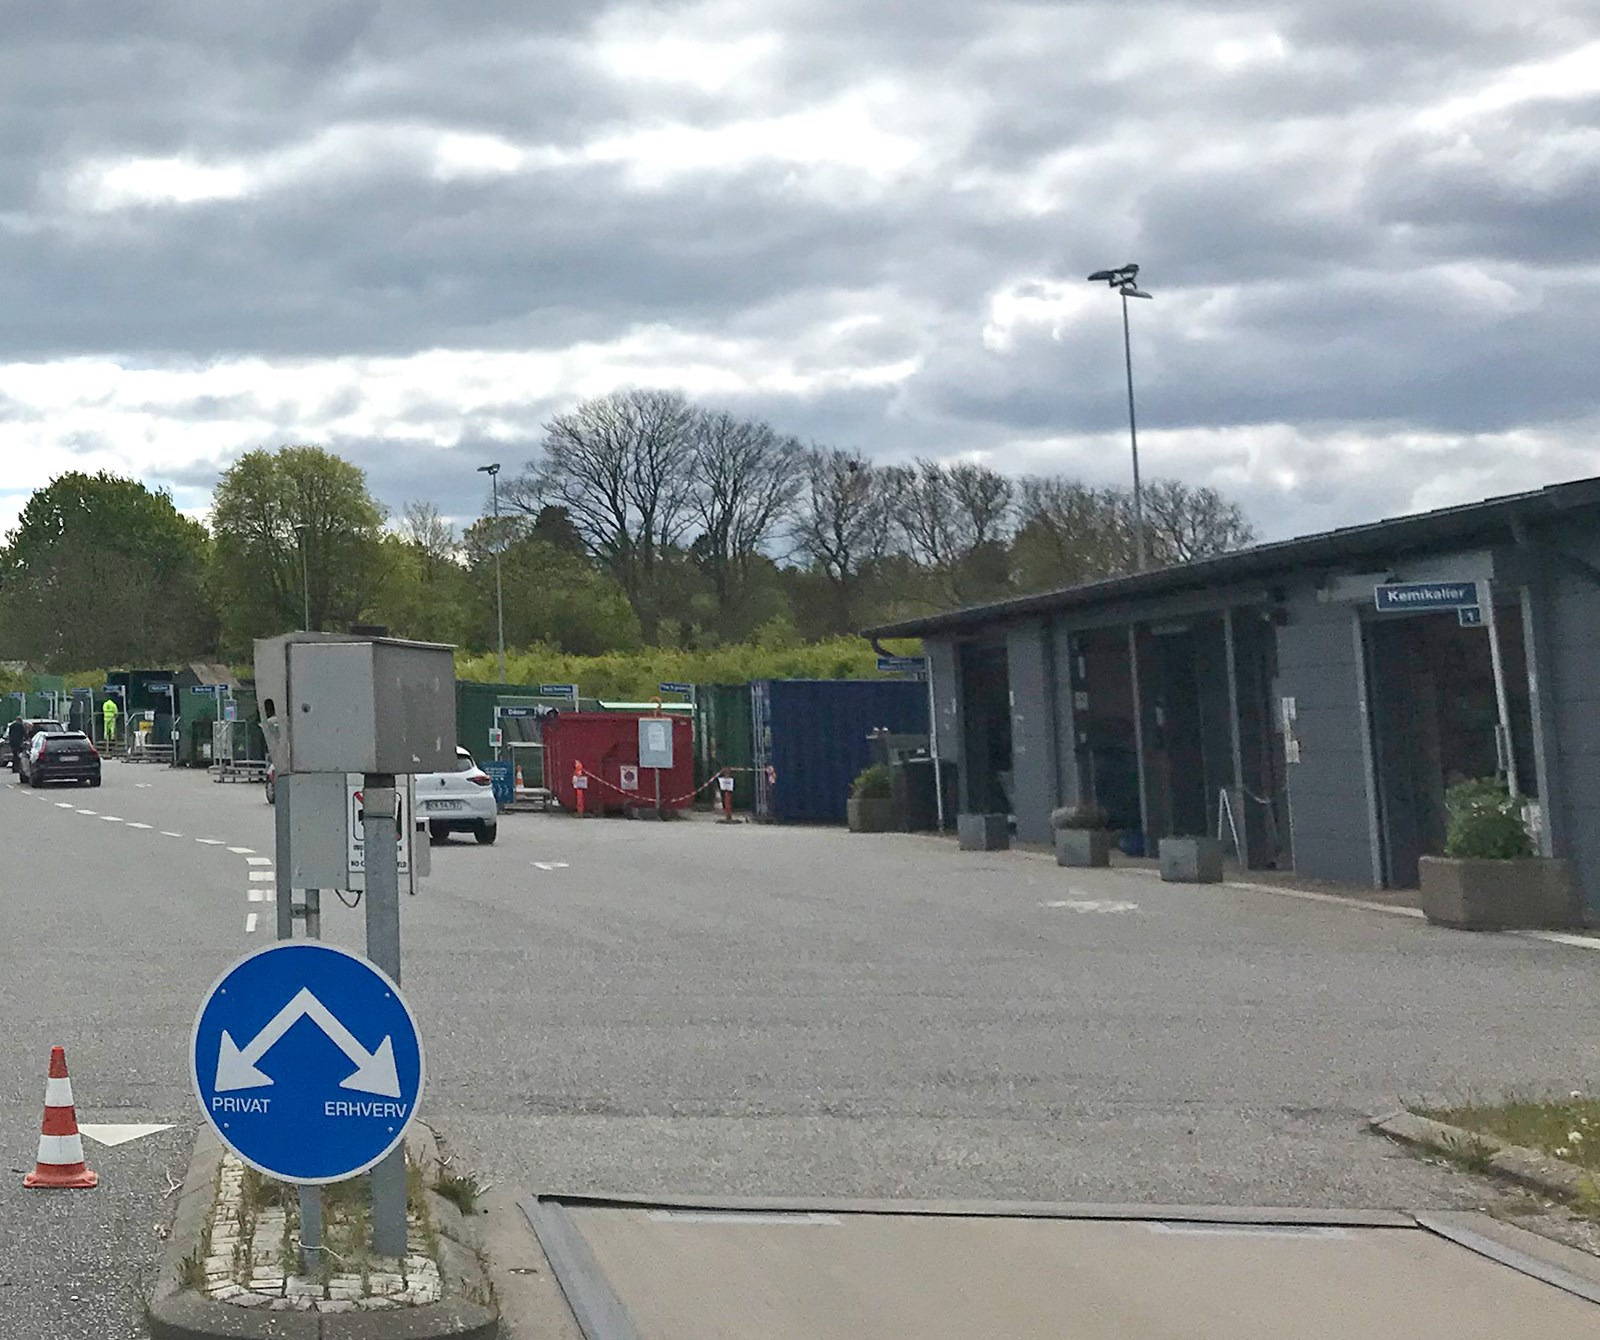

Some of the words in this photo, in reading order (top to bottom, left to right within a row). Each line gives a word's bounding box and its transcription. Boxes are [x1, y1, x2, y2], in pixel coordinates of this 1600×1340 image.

[1386, 587, 1465, 602] Kemikalier
[212, 1097, 271, 1115] PRIVAT
[324, 1101, 408, 1118] ERHVERV
